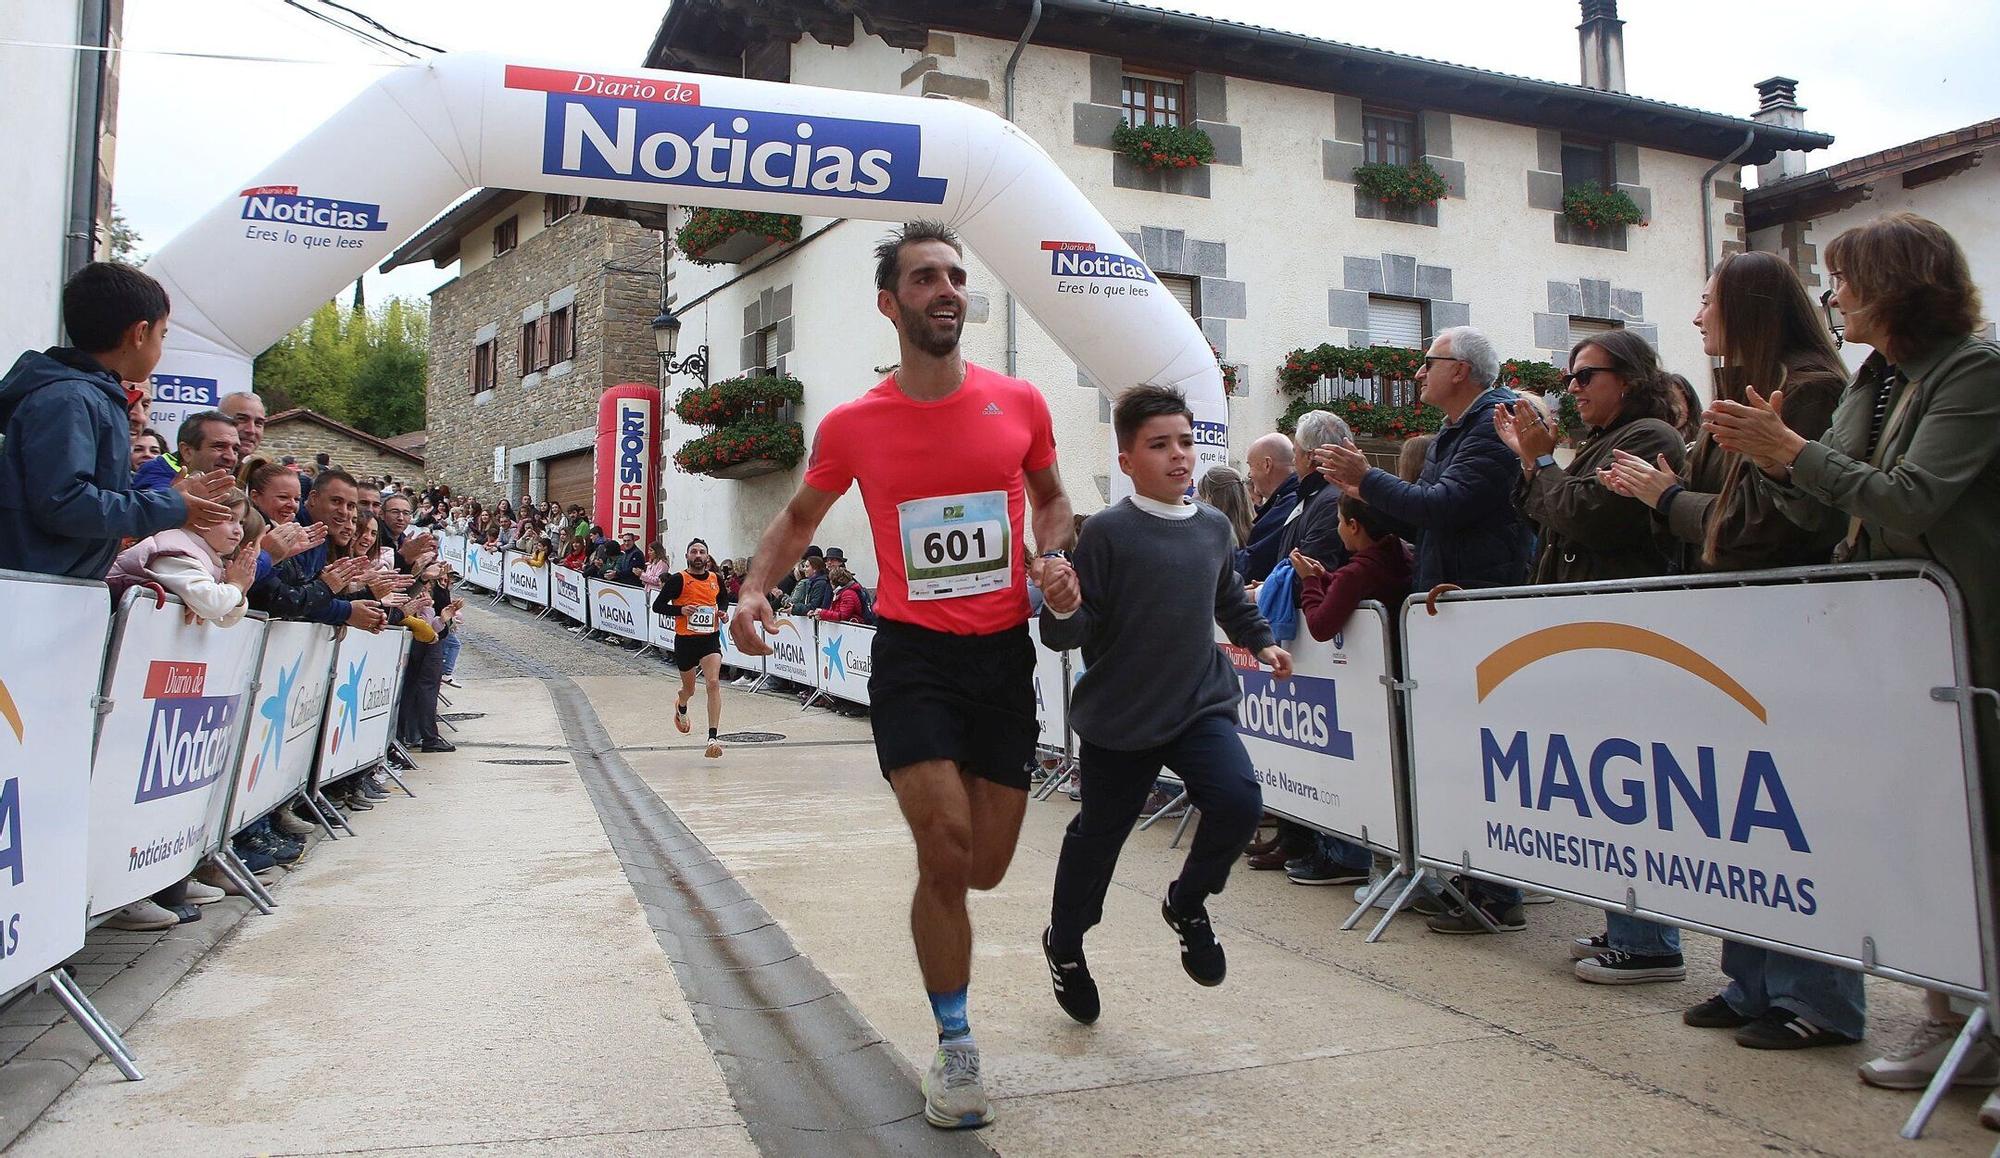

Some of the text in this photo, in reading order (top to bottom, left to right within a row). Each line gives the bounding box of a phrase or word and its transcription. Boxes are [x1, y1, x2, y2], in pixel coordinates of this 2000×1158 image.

[572, 71, 693, 103] Diario de
[562, 102, 892, 194] Noticias
[247, 196, 369, 229] Noticias
[246, 225, 364, 249] Eres lo que lees
[1060, 243, 1095, 252] Diario de
[1057, 253, 1146, 280] Noticias
[1058, 281, 1149, 298] Eres lo que lees
[151, 377, 210, 403] icias
[1192, 424, 1225, 445] ticia
[1200, 452, 1216, 464] que
[617, 406, 645, 541] TERSPORT
[924, 527, 986, 564] 601
[510, 571, 538, 591] MAGNA
[599, 604, 634, 626] MAGNA
[693, 614, 710, 624] 208
[773, 641, 806, 666] MAGNA
[846, 650, 872, 673] CaixaB
[164, 666, 204, 694] Diario de
[1266, 769, 1277, 787] de
[1480, 728, 1811, 854] MAGNA
[129, 837, 172, 872] noticias
[173, 830, 184, 855] de
[1486, 820, 1817, 916] MAGNESITAS NAVARRAS
